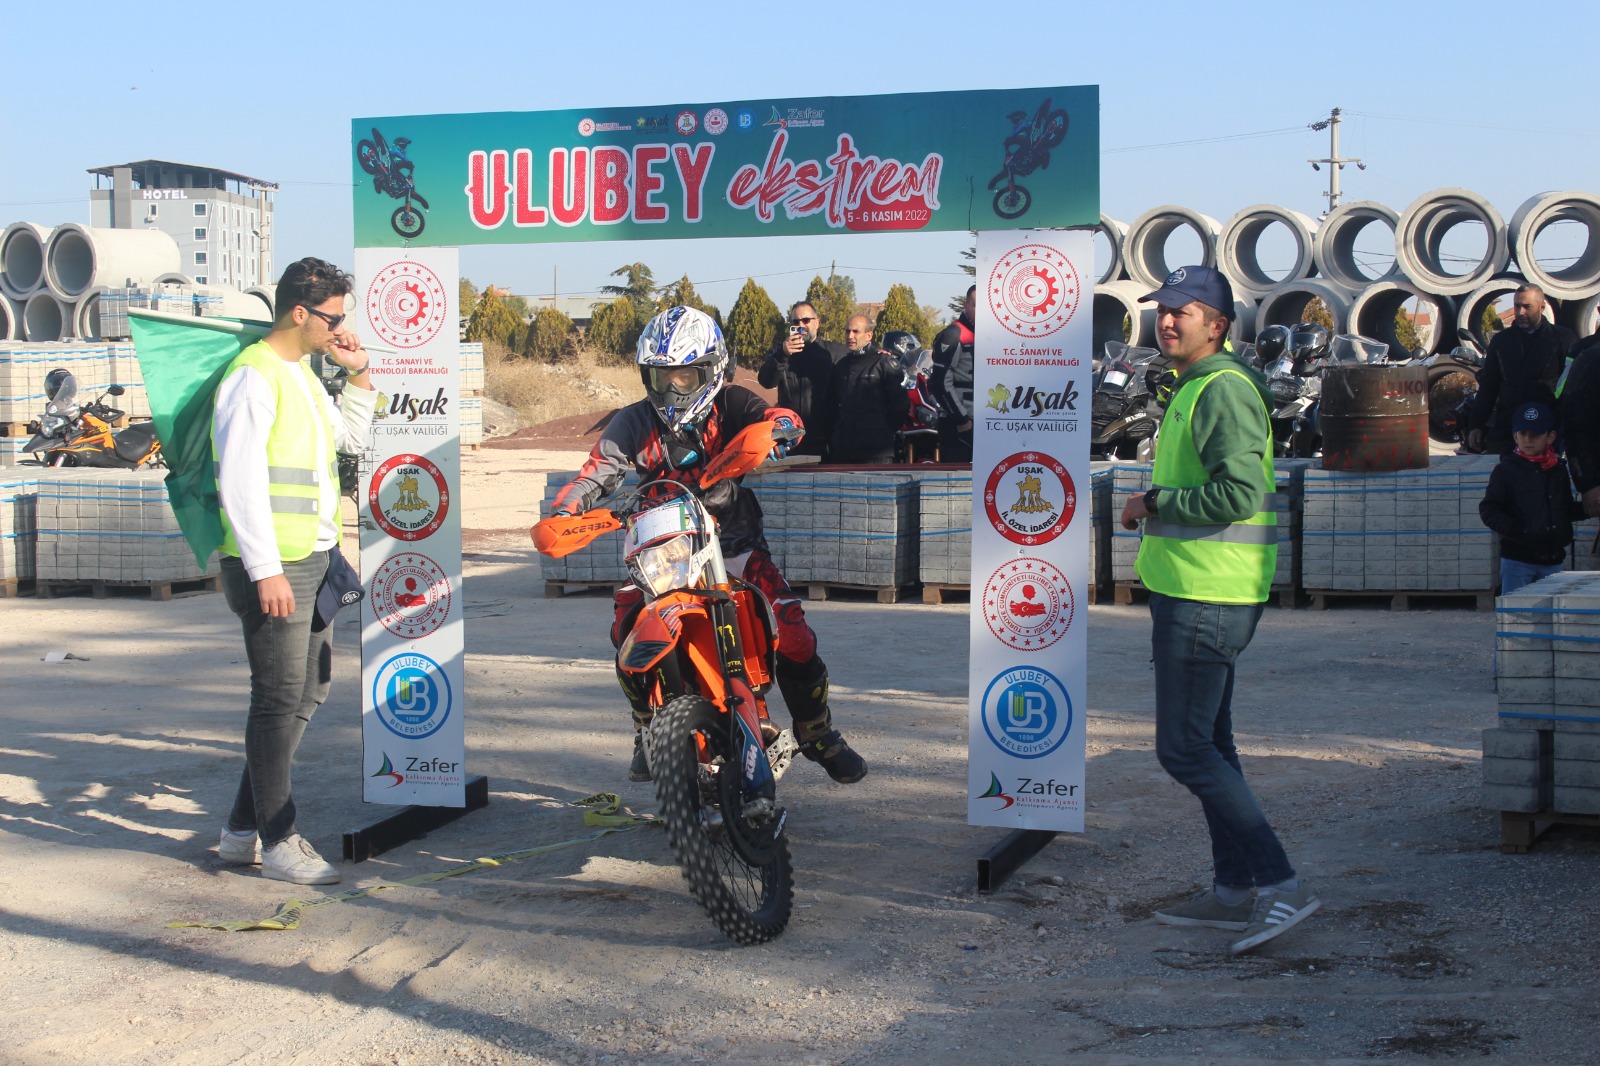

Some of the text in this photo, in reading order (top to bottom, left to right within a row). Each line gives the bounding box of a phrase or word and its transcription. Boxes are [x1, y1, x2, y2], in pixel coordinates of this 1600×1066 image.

[787, 107, 825, 119] Zafer
[465, 130, 943, 230] ULUBEY ekstrem
[143, 190, 188, 200] HOTEL
[847, 211, 854, 223] 5
[862, 211, 869, 222] 6
[871, 210, 903, 222] KASIM
[905, 209, 928, 221] 2022
[1003, 347, 1063, 356] T.C. SANAYİ VE
[396, 357, 422, 365] SANAYİ
[986, 357, 1080, 367] TEKNOLOJİ BAKANLIĞI
[408, 366, 449, 375] BAKANLIĞI
[389, 387, 449, 423] Uşak
[1011, 380, 1079, 418] Uşak
[386, 426, 410, 437] UŞAK
[412, 425, 448, 436] VALİLİĞİ
[985, 421, 1077, 433] T.C. UŞAK VALİLİĞİ
[397, 467, 420, 476] UŞAK
[1017, 466, 1044, 476] UŞAK
[384, 509, 435, 529] İL ÖZEL İDARESİ
[1001, 510, 1058, 532] İL ÖZEL İDARESİ
[410, 568, 432, 582] ULUBEY
[1028, 574, 1053, 590] ULUBEY
[392, 657, 432, 672] ULUBEY
[1005, 670, 1050, 686] ULUBEY
[389, 718, 437, 734] BELEDİYESİ
[1000, 736, 1053, 752] BELEDİYESİ
[405, 757, 459, 773] Zafer
[1016, 778, 1079, 797] Zafer
